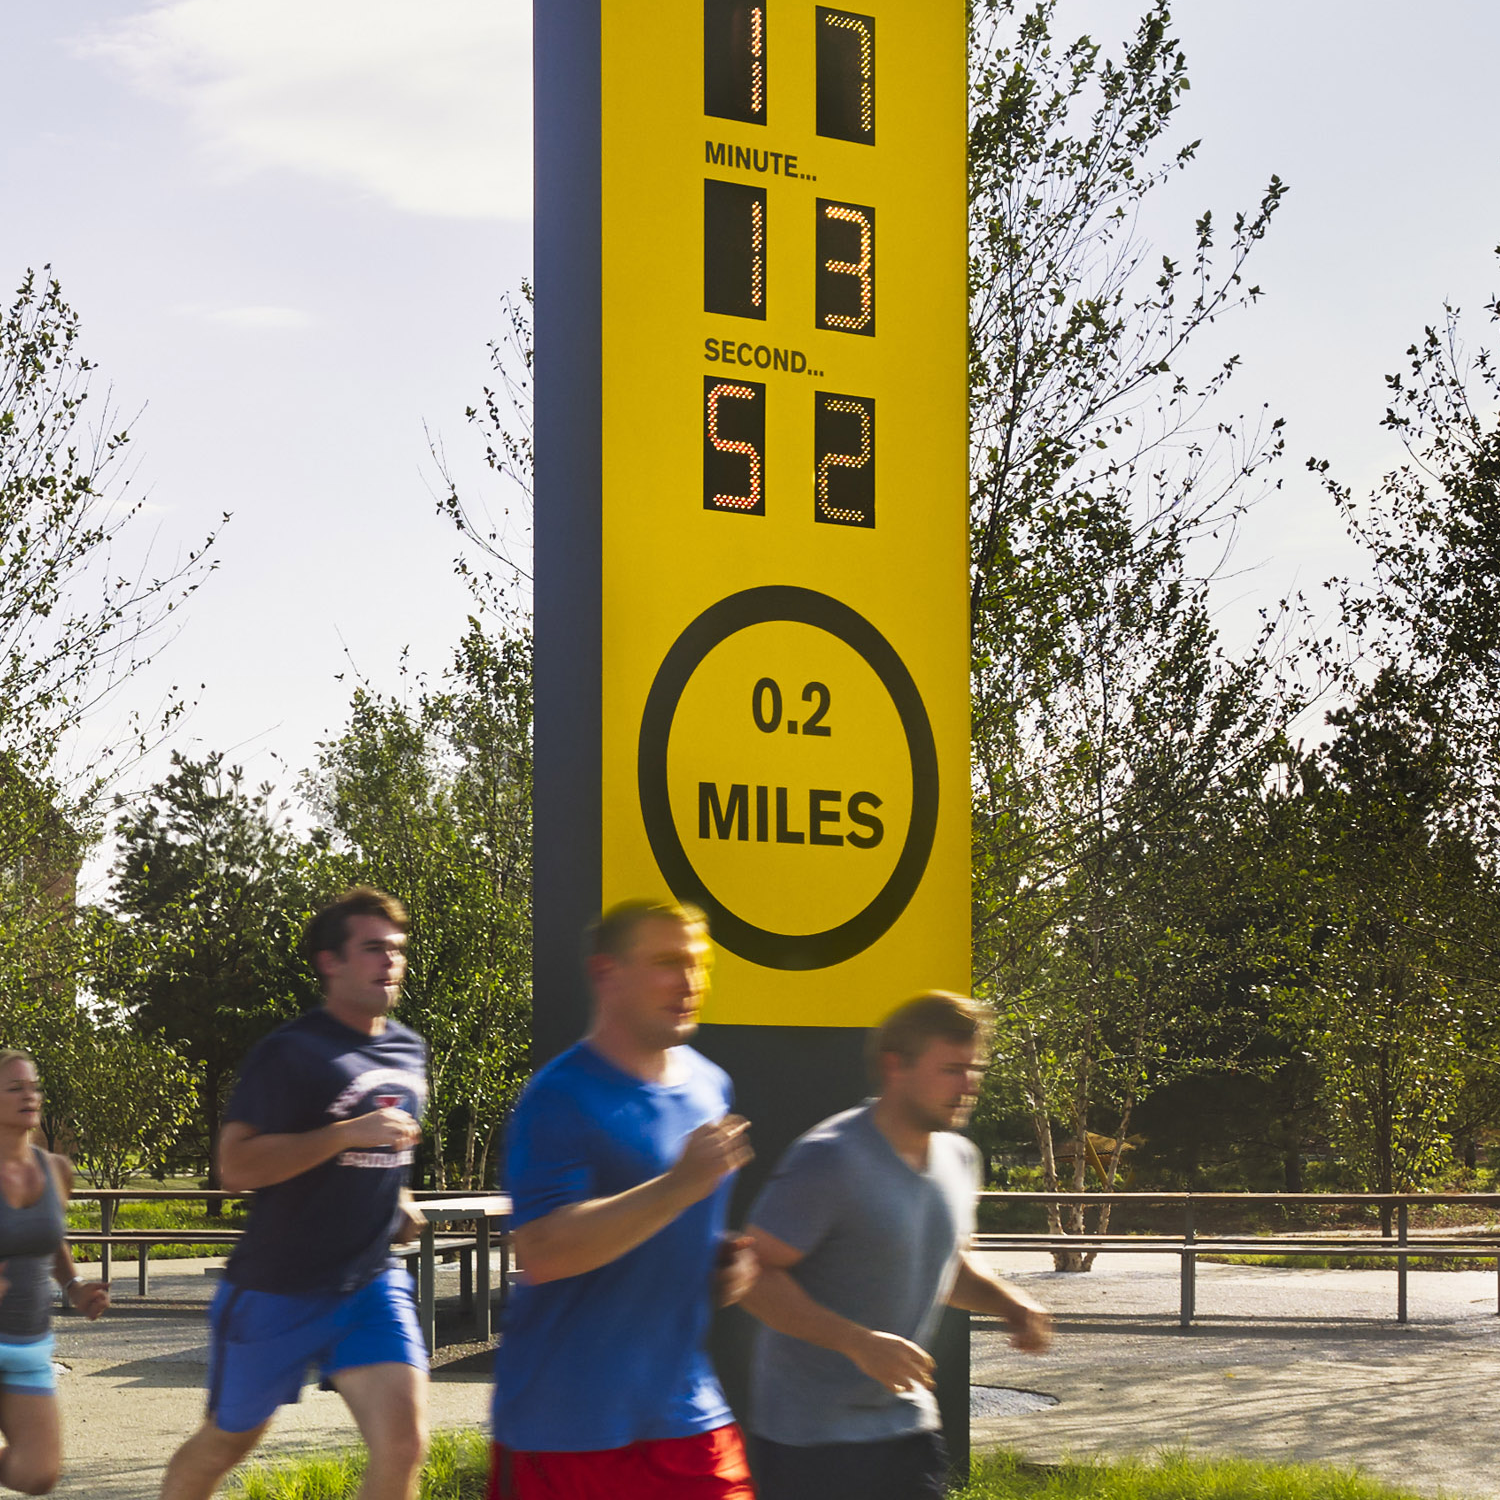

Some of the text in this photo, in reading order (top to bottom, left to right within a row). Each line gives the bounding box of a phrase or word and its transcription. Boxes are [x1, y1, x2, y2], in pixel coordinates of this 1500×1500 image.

[704, 140, 817, 182] MINUTE...
[704, 337, 826, 378] SECOND...
[752, 677, 832, 738] 0.2
[698, 781, 885, 850] MILES
